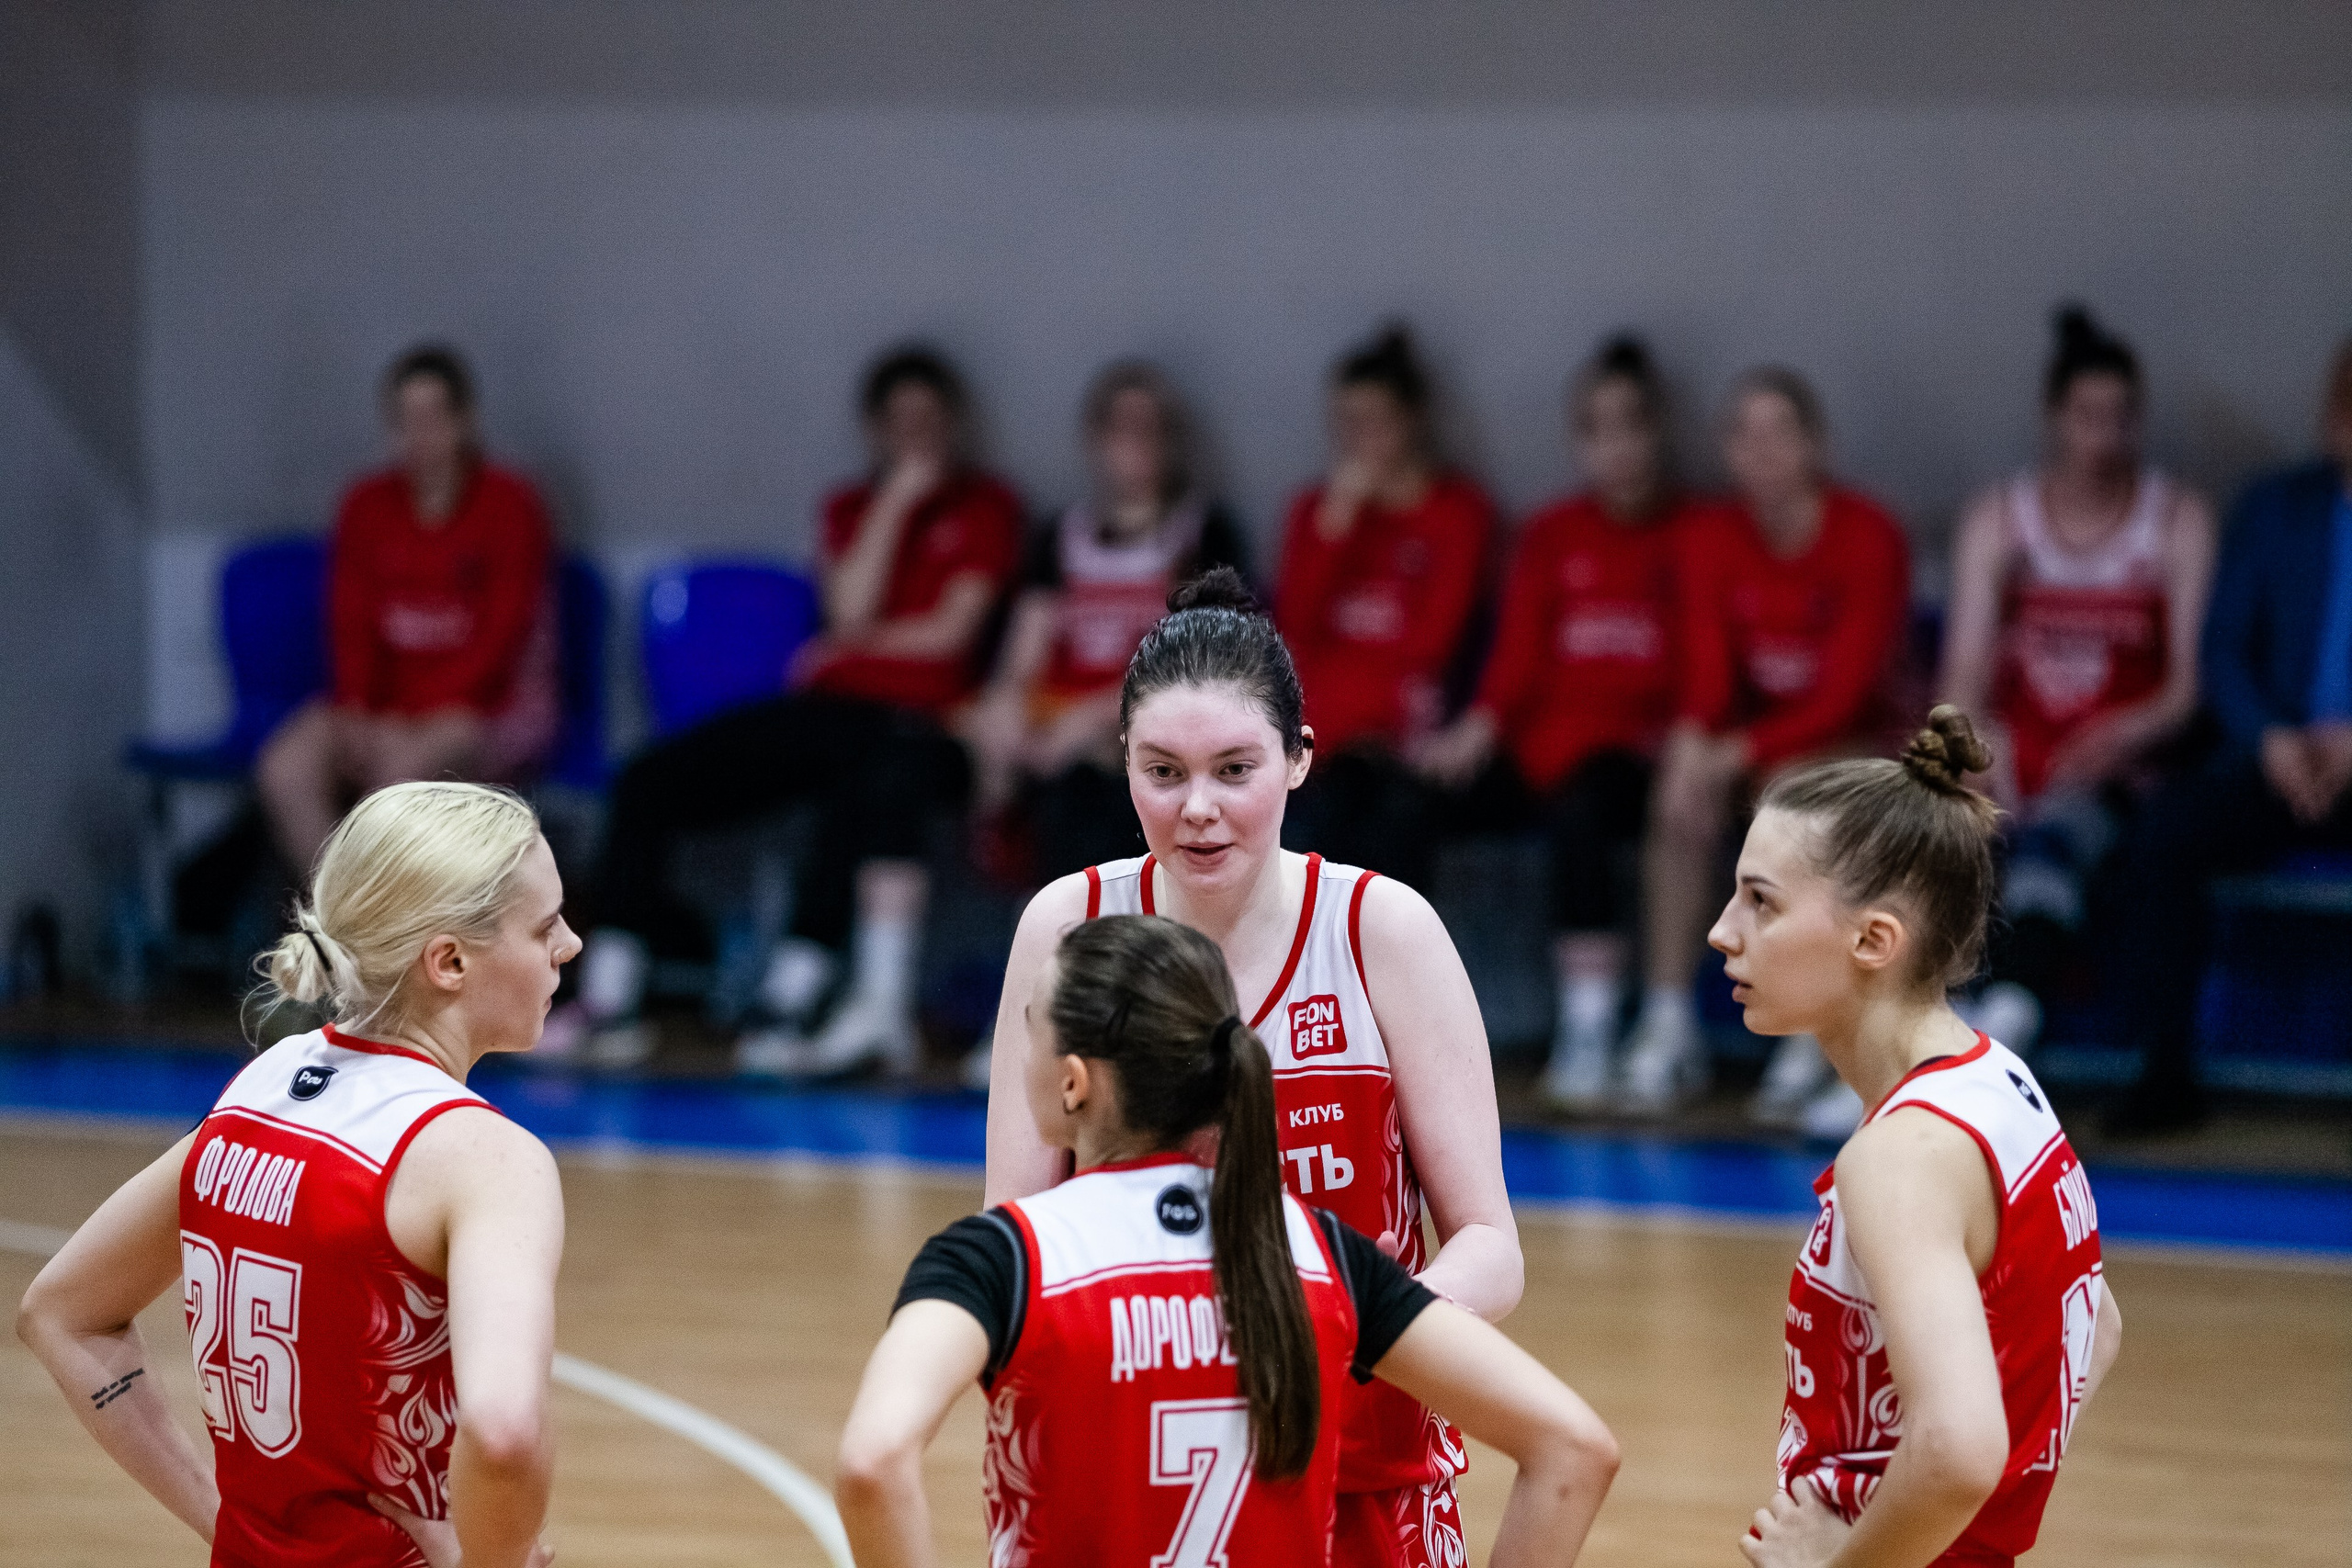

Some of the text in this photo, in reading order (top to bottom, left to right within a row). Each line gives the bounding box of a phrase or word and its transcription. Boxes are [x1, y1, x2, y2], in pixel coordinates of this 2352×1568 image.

[1293, 1001, 1335, 1031] FON
[1295, 1022, 1340, 1054] BET
[1289, 1103, 1345, 1128] КЛУБ
[194, 1134, 307, 1227] ФРОЛОВА
[1279, 1143, 1355, 1195] ТЬ
[180, 1228, 303, 1460] 25
[1148, 1397, 1259, 1568] 7
